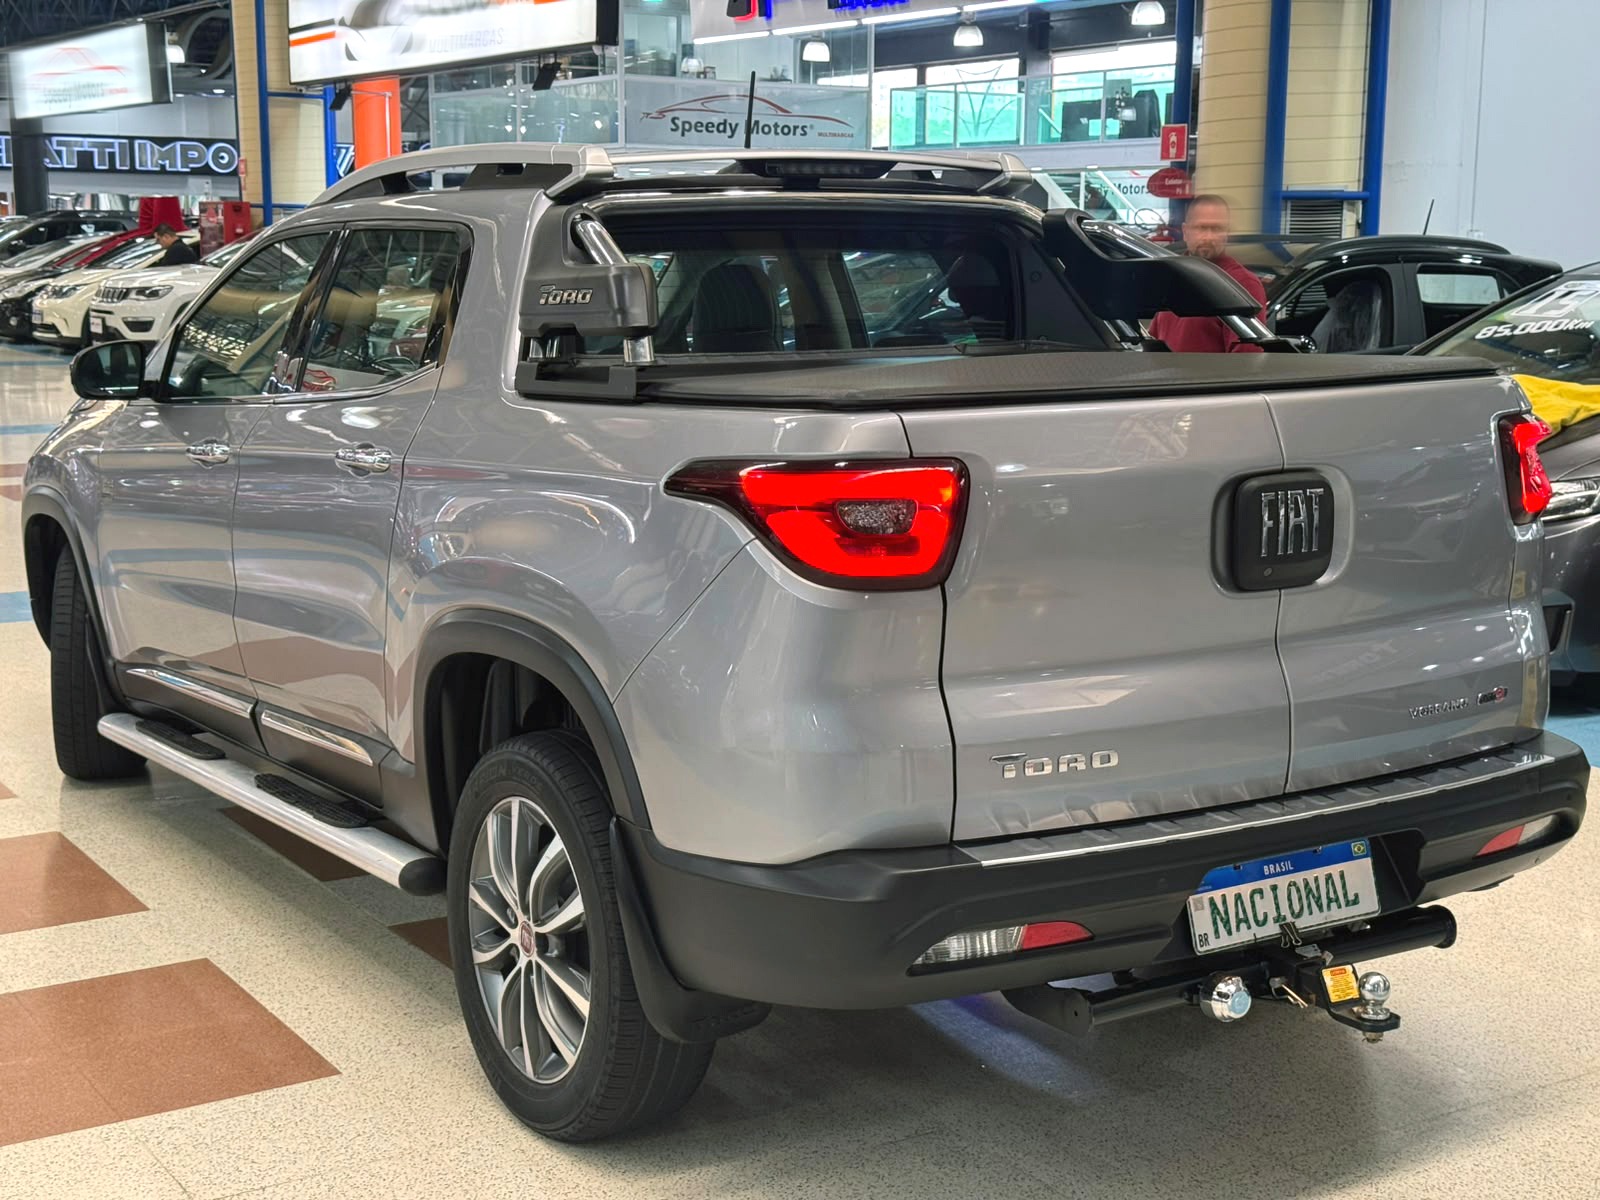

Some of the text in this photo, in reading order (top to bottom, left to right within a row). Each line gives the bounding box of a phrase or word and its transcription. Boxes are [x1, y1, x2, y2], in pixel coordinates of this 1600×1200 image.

[670, 116, 739, 138] Speedy
[539, 284, 593, 305] TORO
[1261, 488, 1324, 557] FIAT
[990, 750, 1119, 779] TORO
[1263, 860, 1294, 876] BRASIL
[1208, 869, 1361, 940] NACIONAL
[1198, 933, 1210, 948] BR
